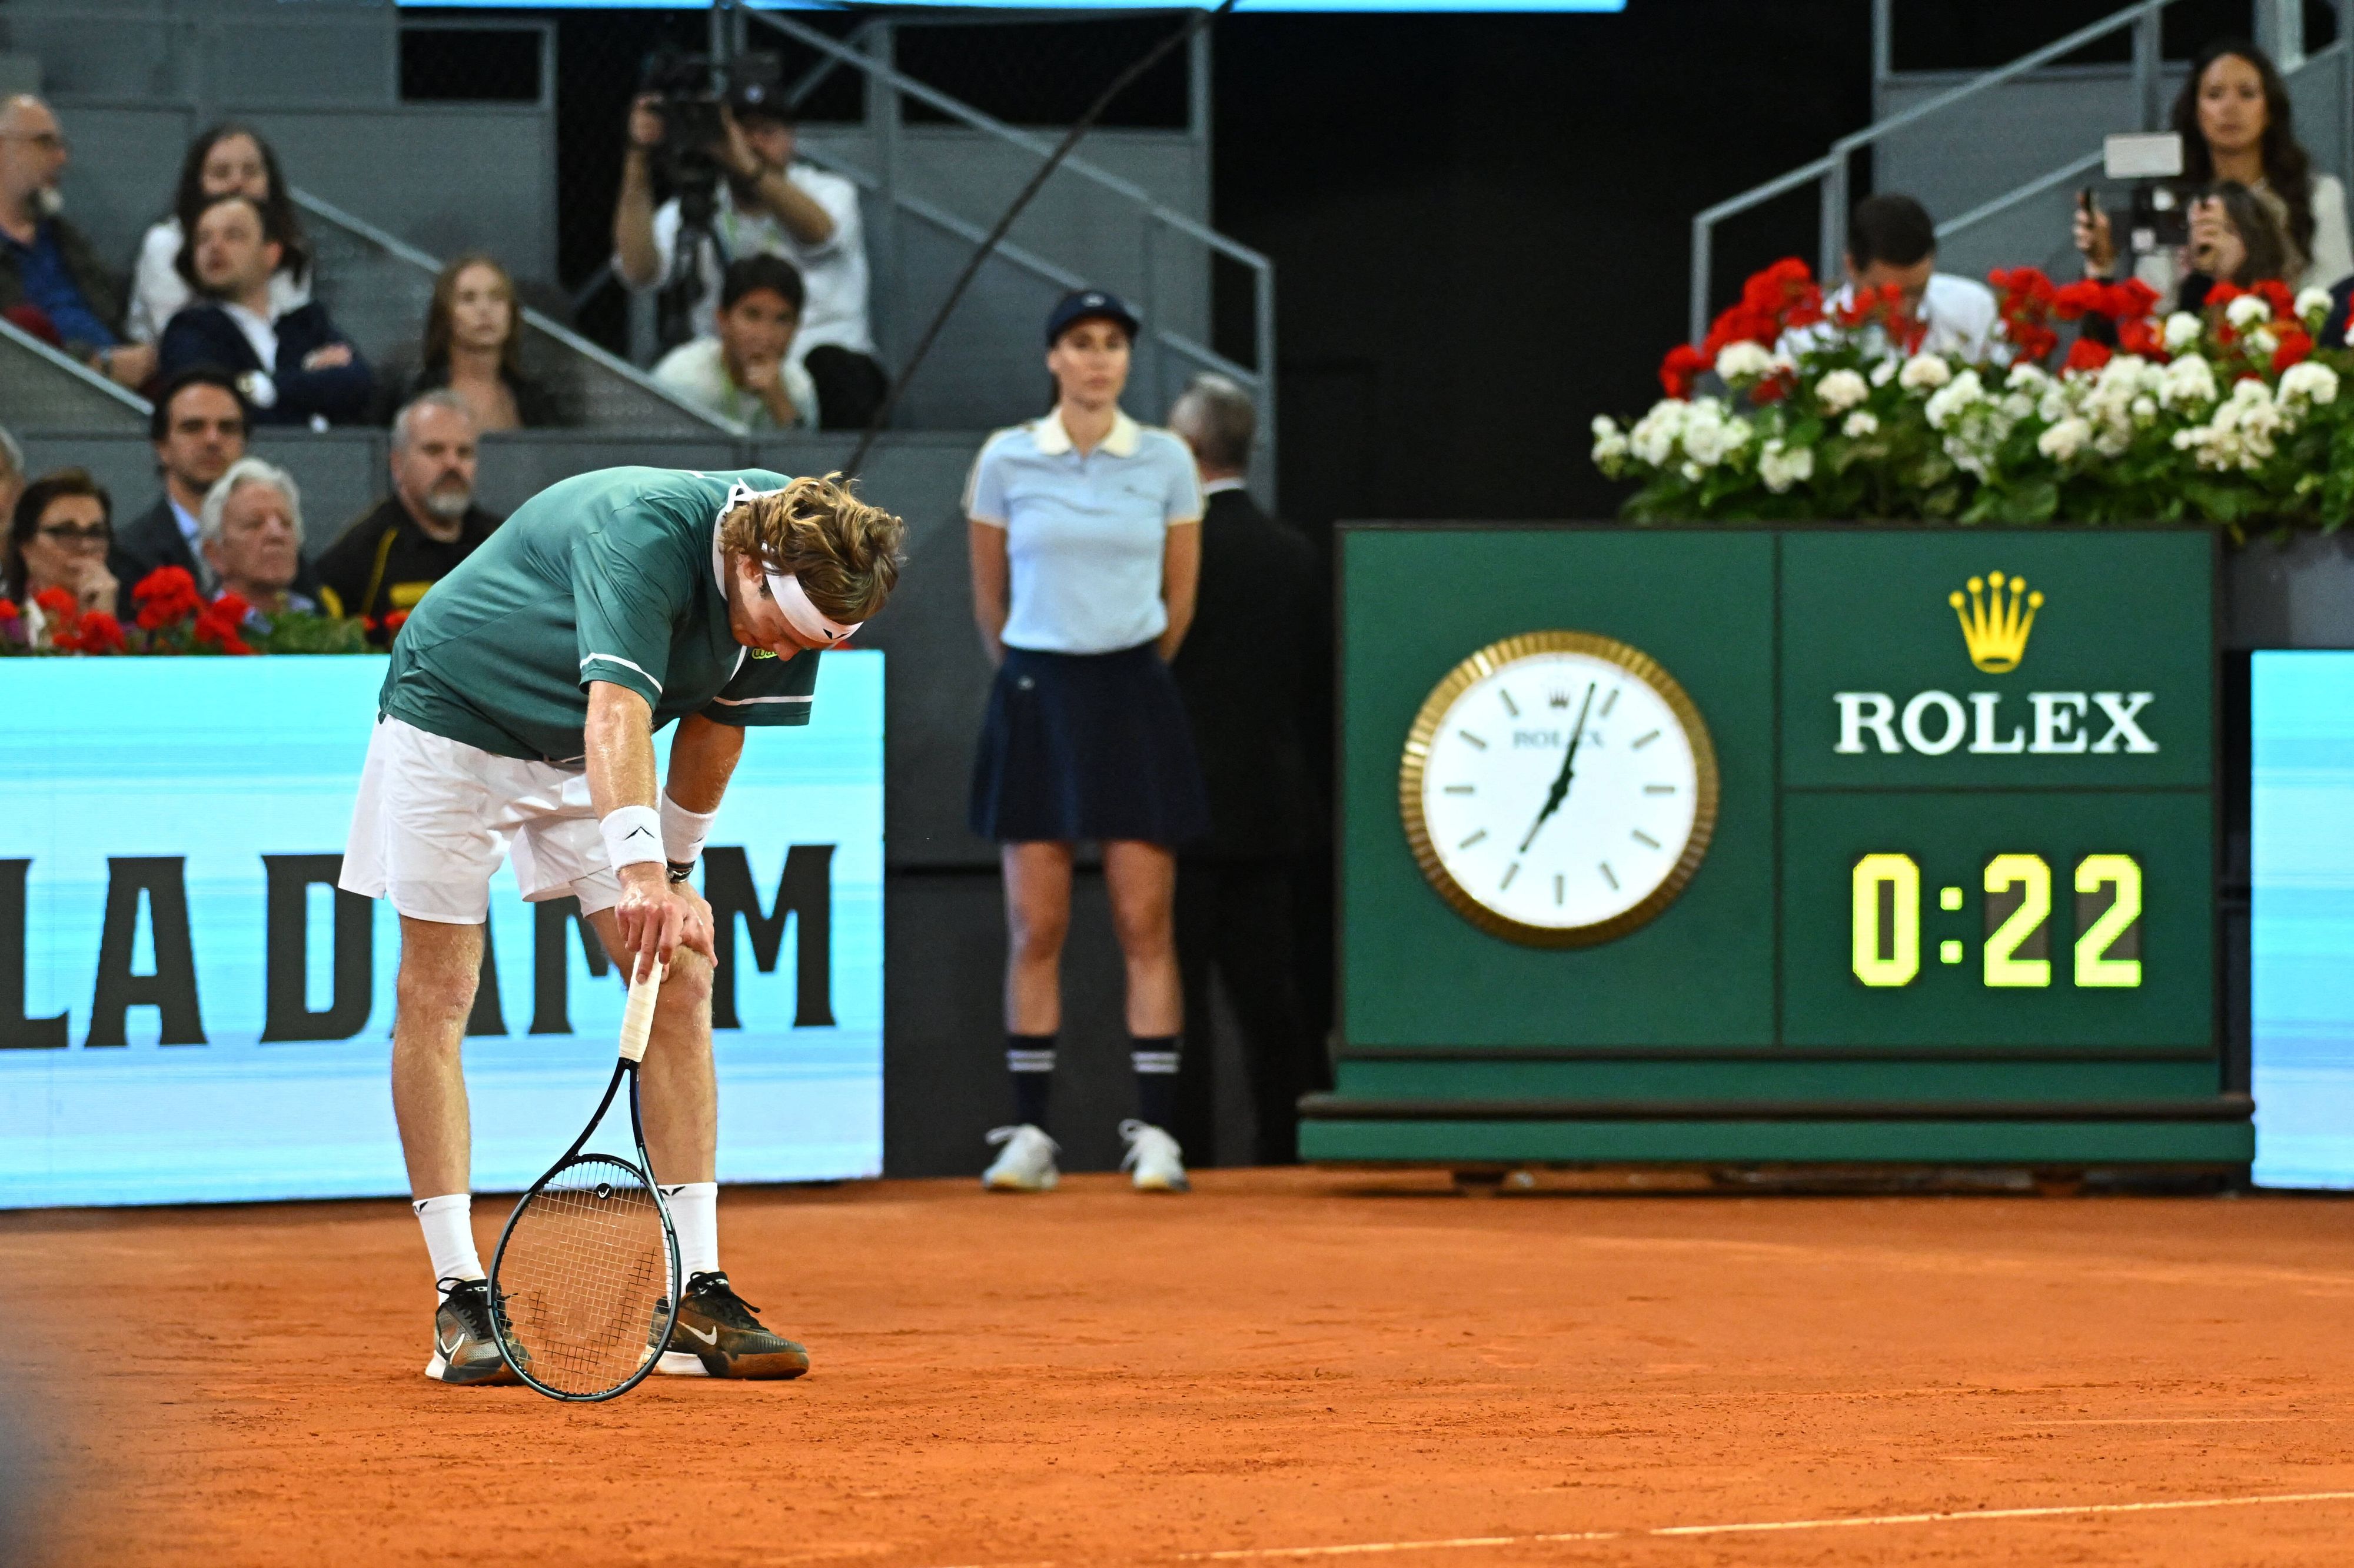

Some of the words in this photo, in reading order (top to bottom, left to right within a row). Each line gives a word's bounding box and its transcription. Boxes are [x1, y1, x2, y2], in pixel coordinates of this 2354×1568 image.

[1513, 729, 1606, 749] ROLX
[1834, 691, 2158, 755] ROLEX
[1852, 853, 2142, 987] 0:22
